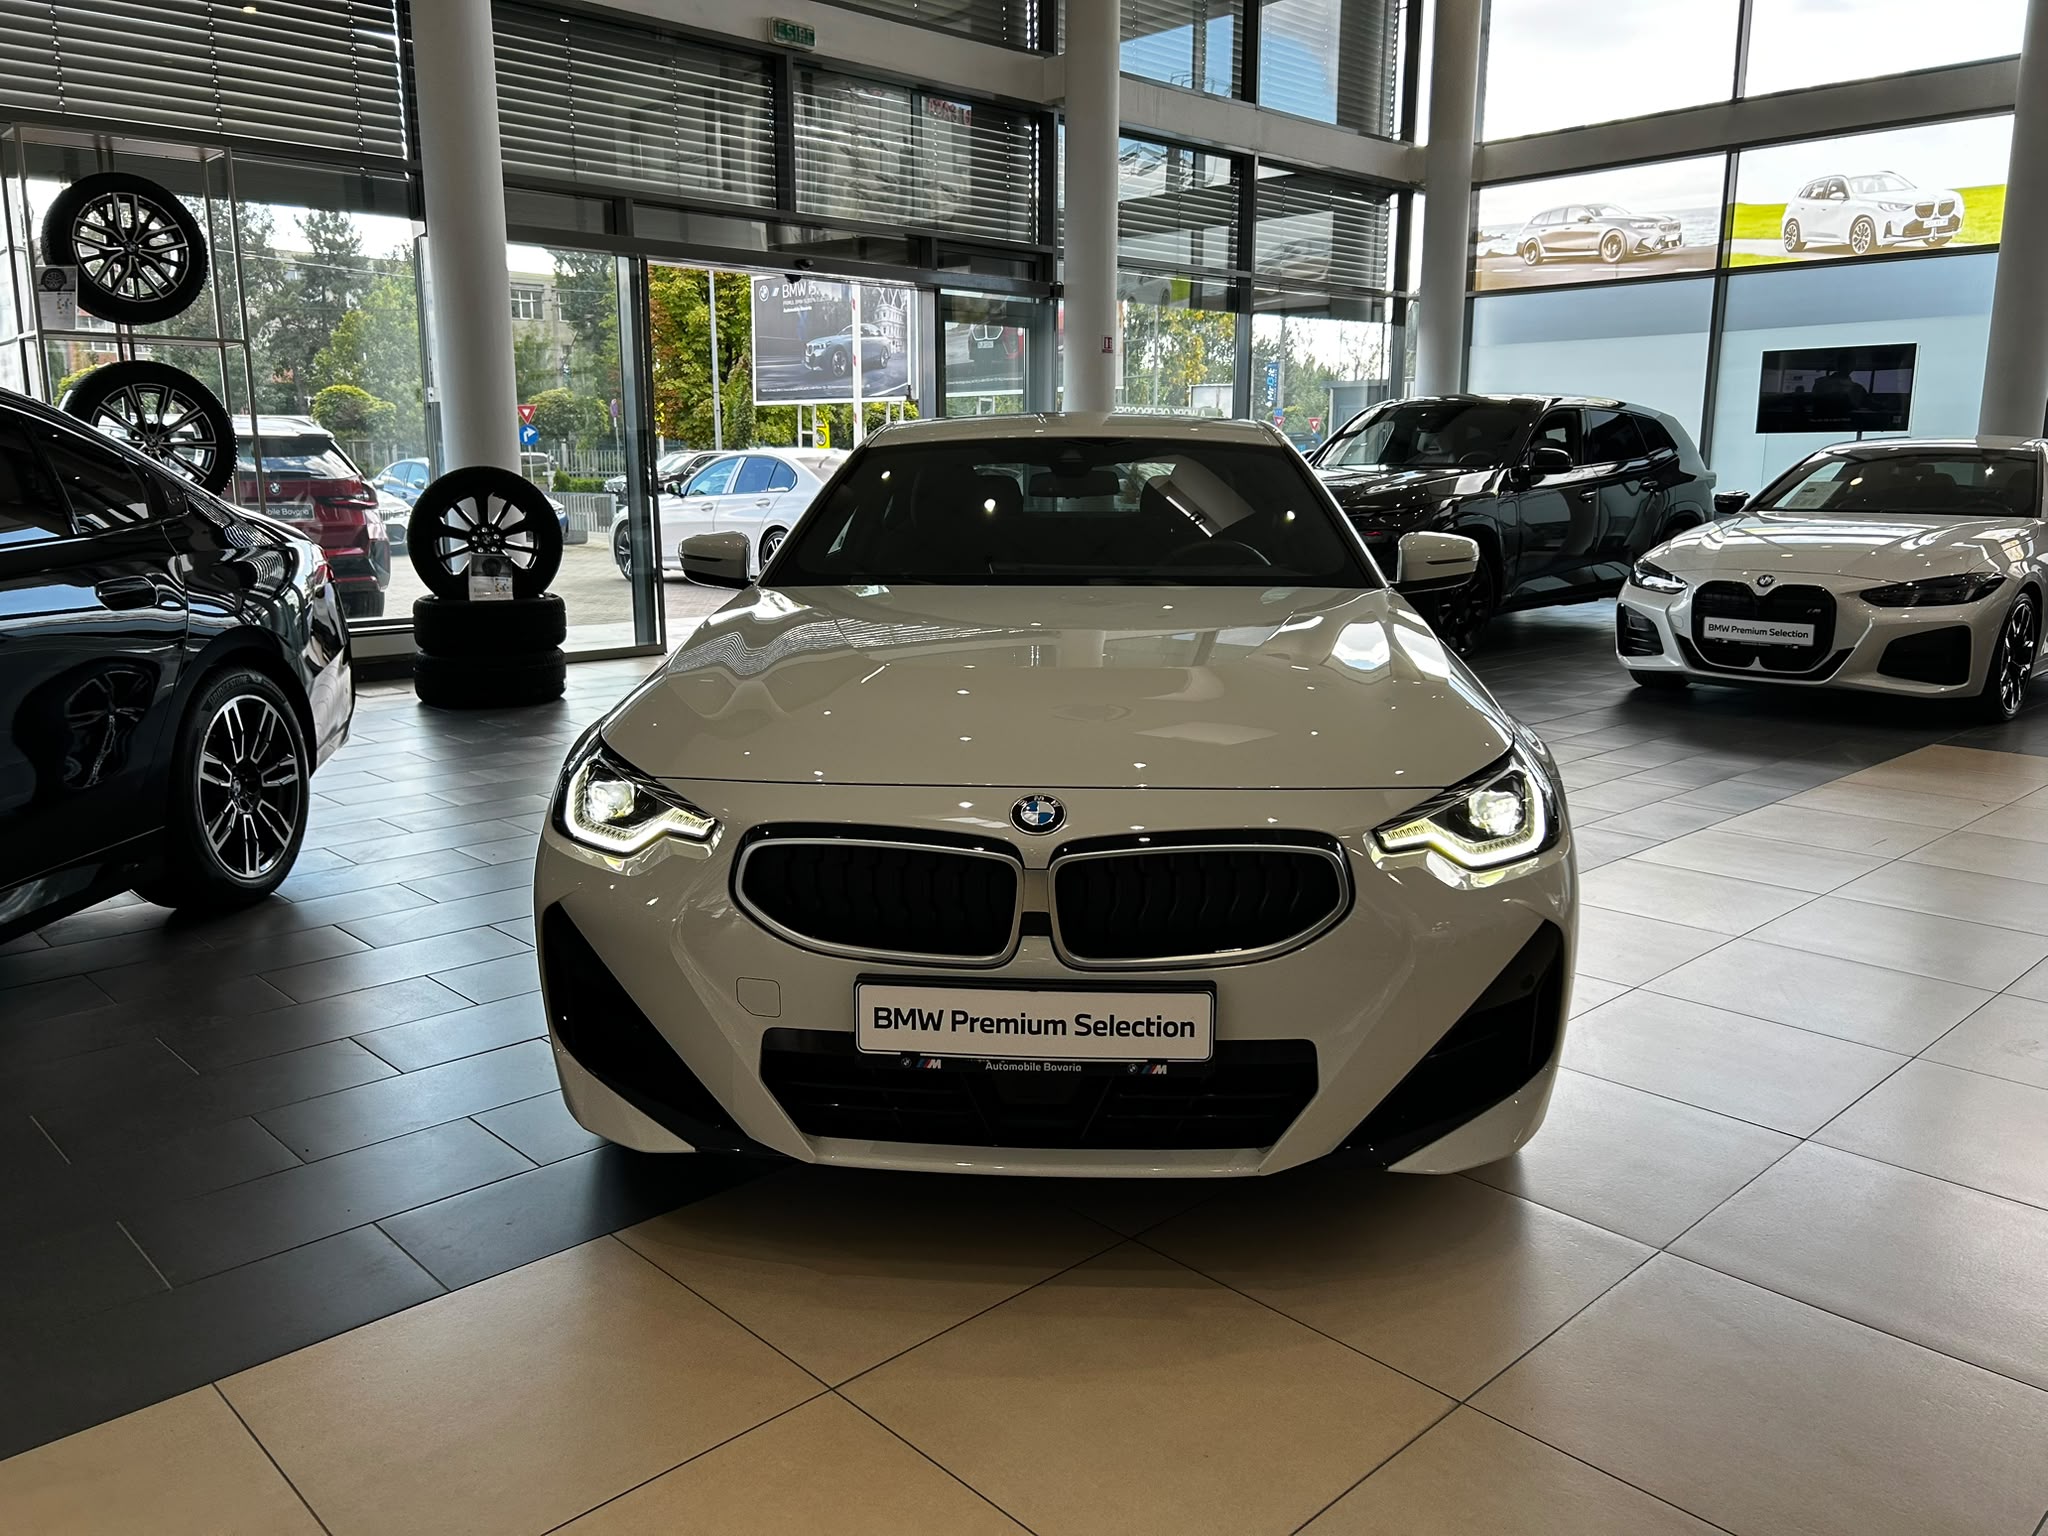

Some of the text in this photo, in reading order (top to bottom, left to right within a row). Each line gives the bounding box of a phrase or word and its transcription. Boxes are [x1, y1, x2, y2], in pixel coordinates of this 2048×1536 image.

[782, 282, 807, 298] BMW
[1708, 623, 1809, 638] BMW Premium Selection
[873, 1006, 1196, 1038] BMW Premium Selection
[985, 1061, 1082, 1072] Automobile Bavaria
